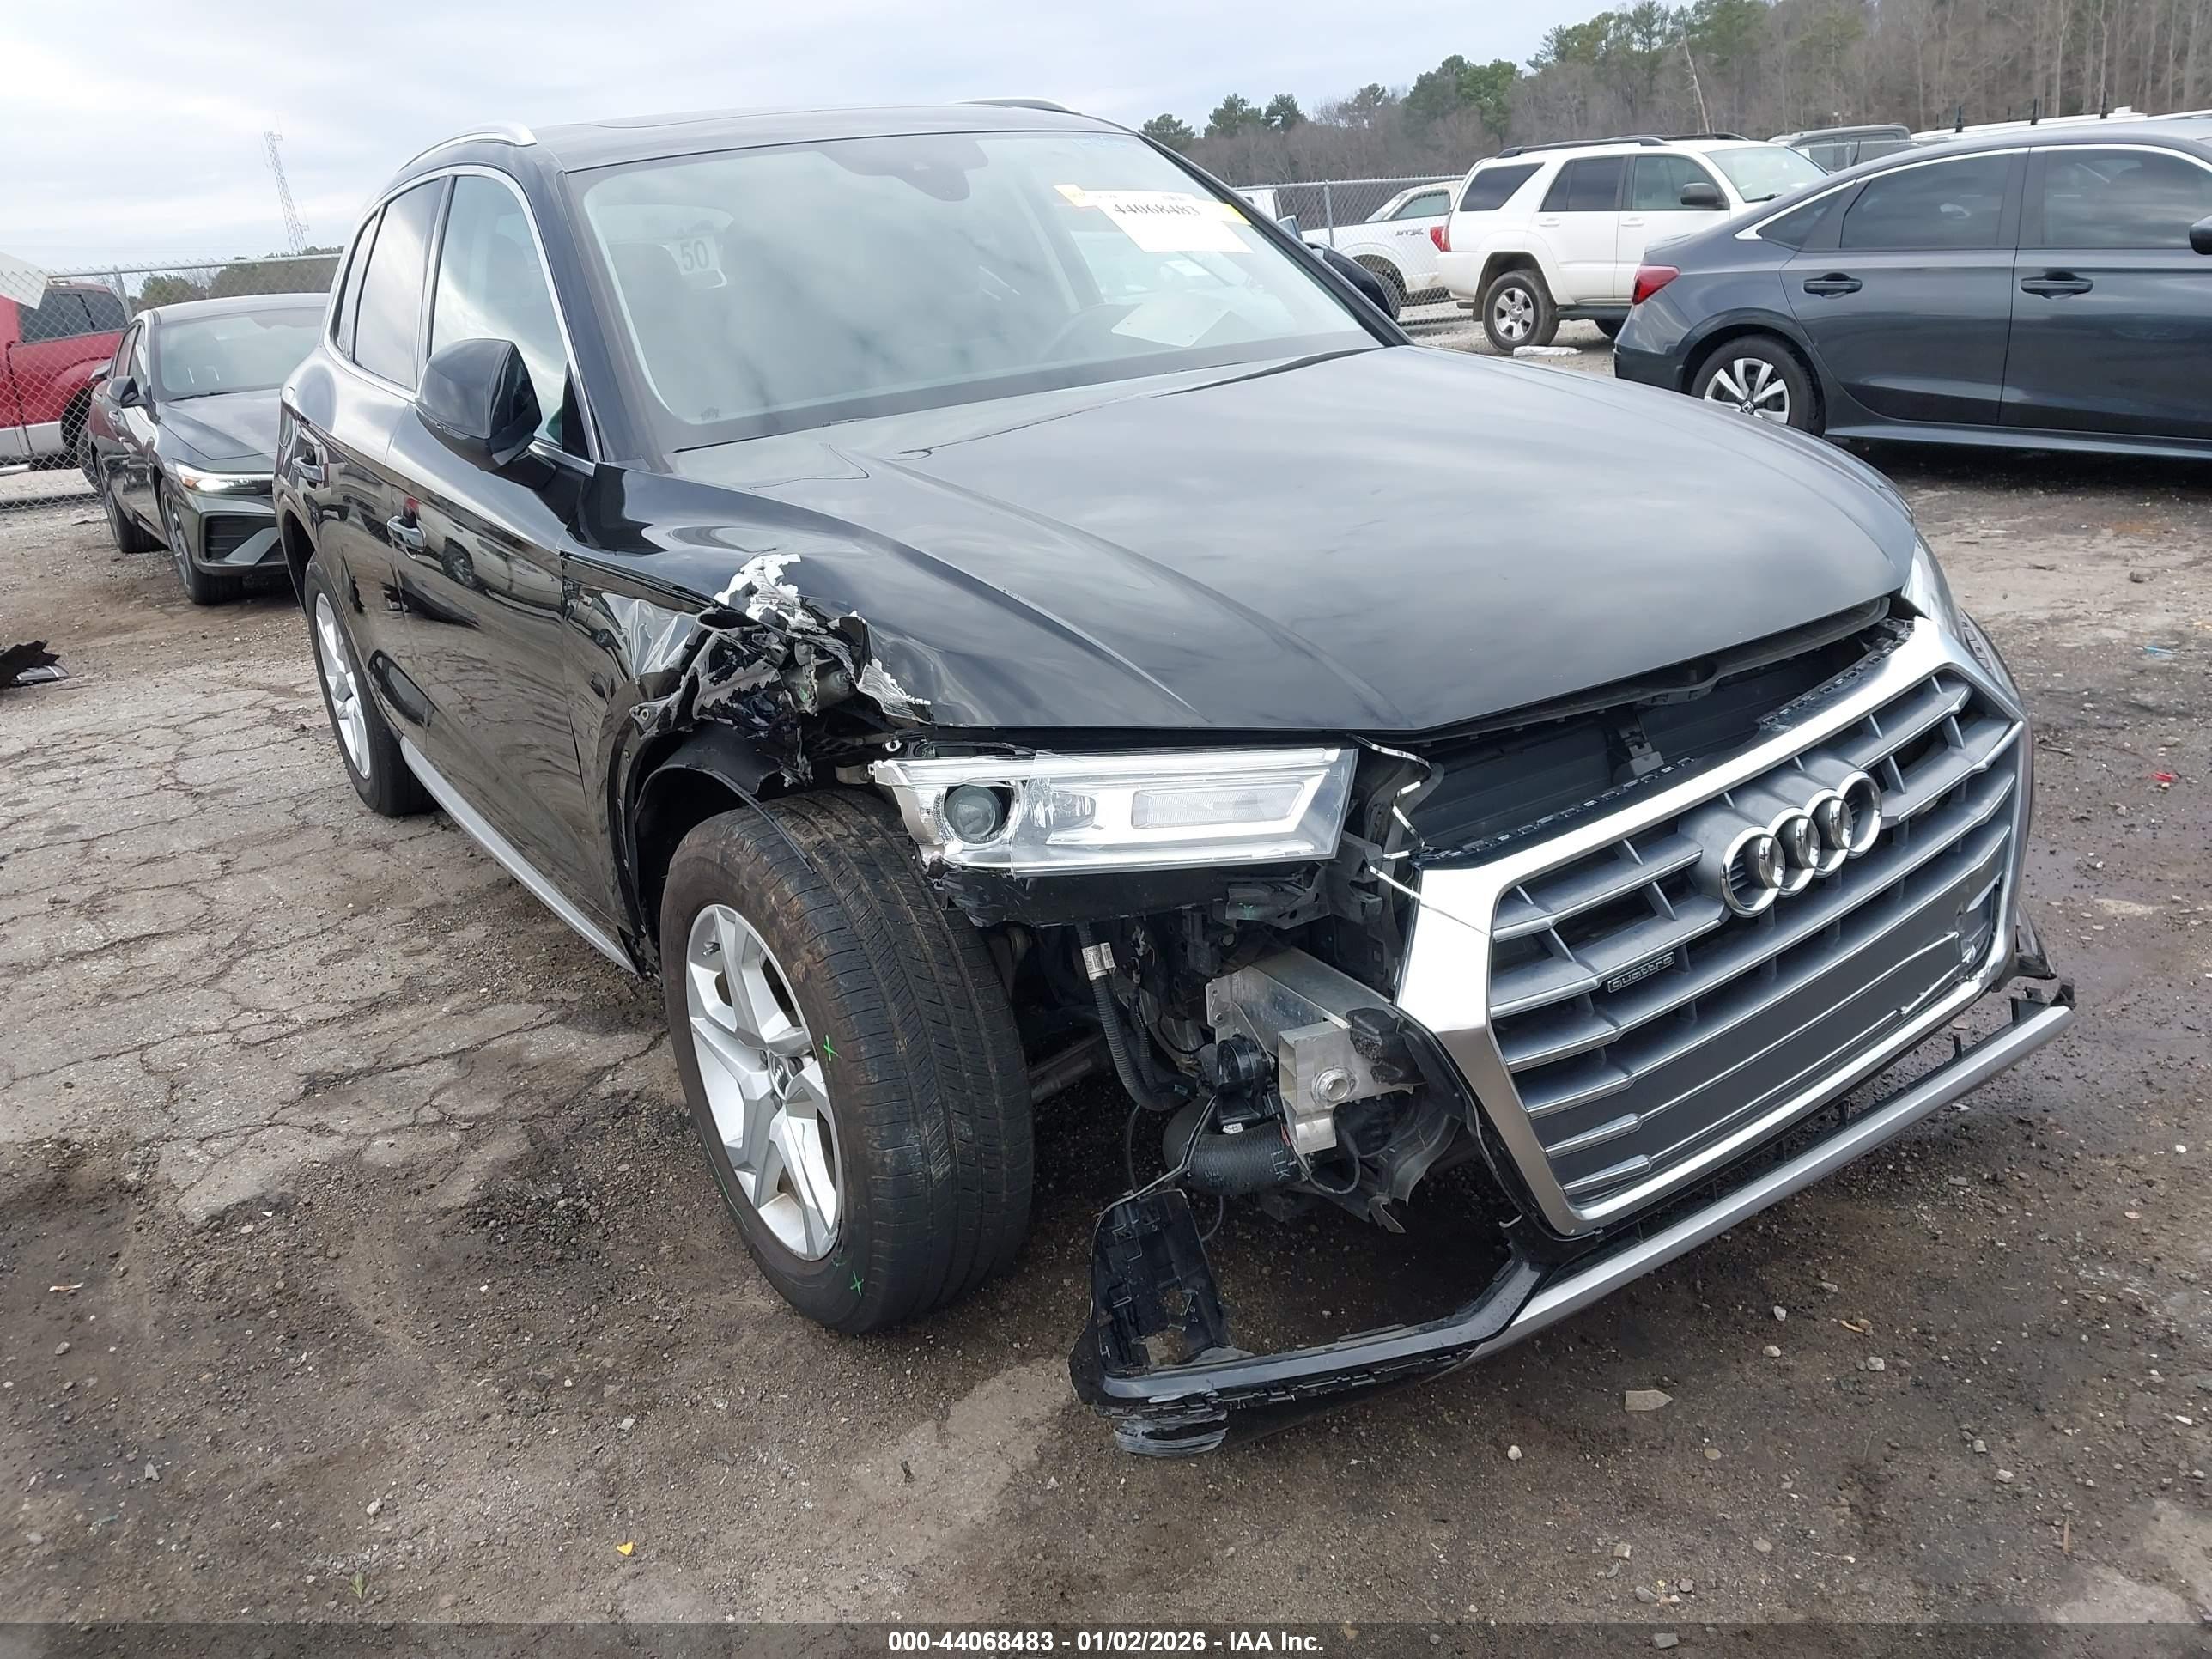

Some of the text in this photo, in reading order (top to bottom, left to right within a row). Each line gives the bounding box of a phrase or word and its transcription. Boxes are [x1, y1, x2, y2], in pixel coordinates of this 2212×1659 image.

[1113, 203, 1201, 216] 44068483
[679, 240, 710, 272] 50
[1612, 956, 1674, 989] quattro
